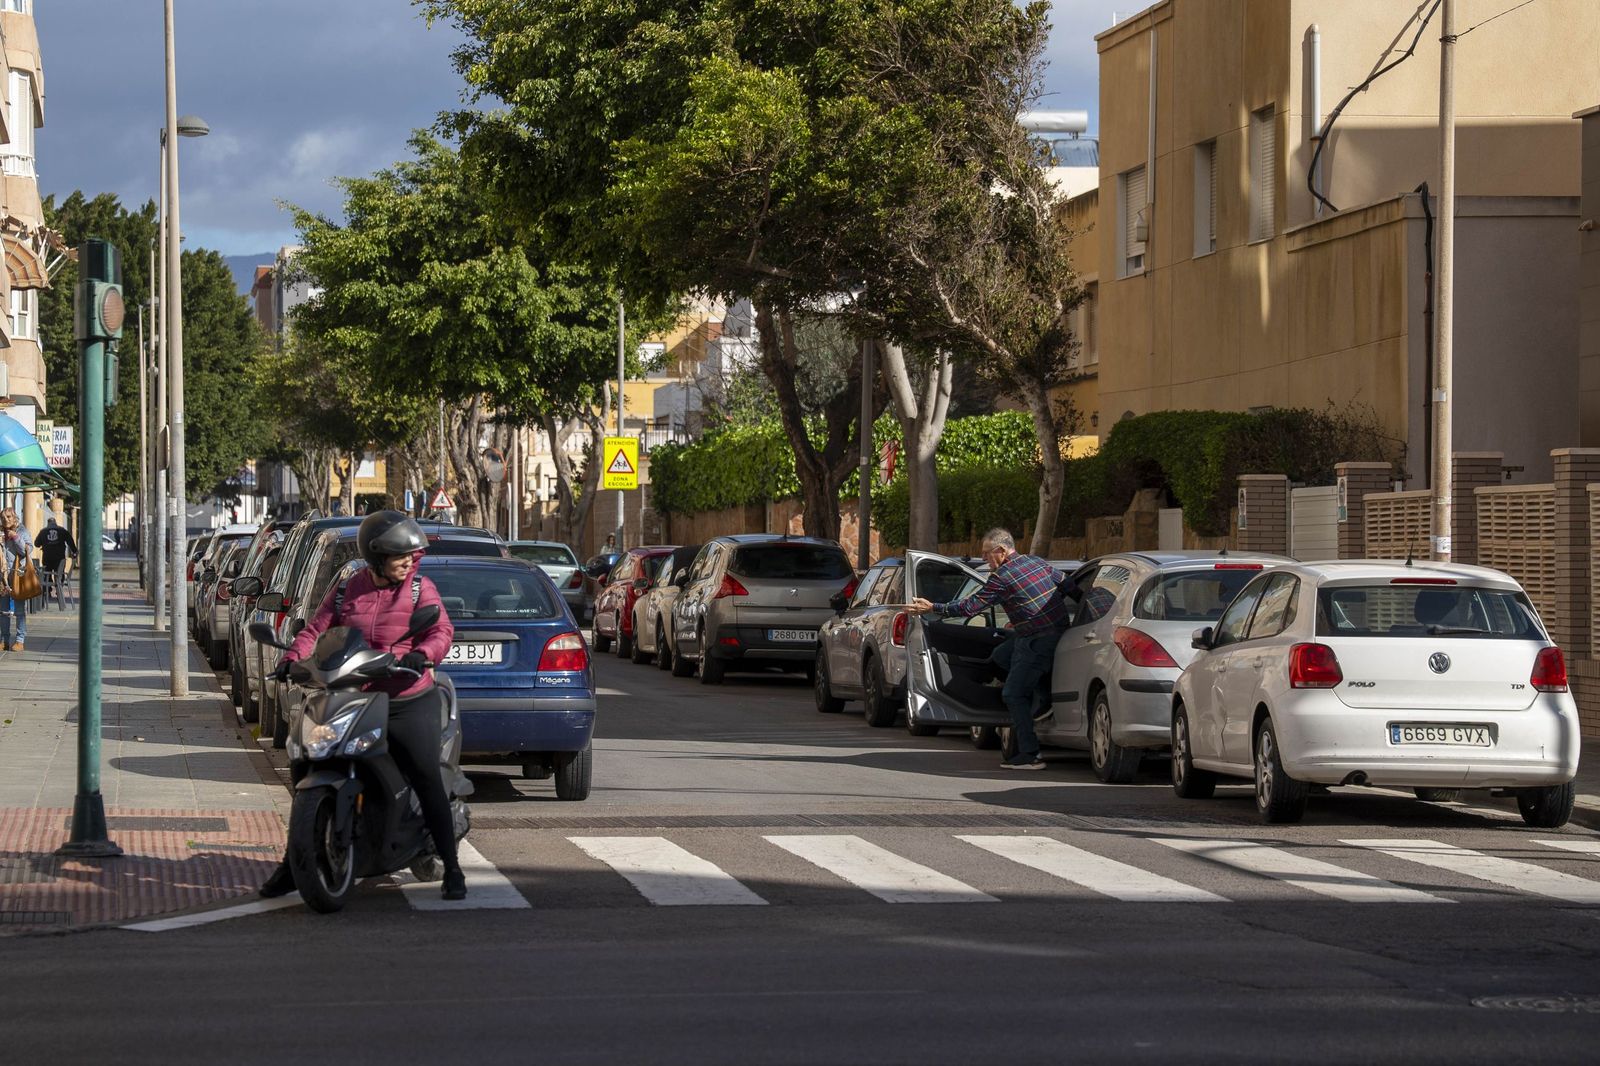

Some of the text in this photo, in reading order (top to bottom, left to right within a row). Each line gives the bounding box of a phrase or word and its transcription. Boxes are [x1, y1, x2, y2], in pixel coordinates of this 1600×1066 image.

[774, 630, 797, 640] 2680
[467, 644, 496, 659] BJY
[1403, 727, 1485, 744] 6669 GVX
